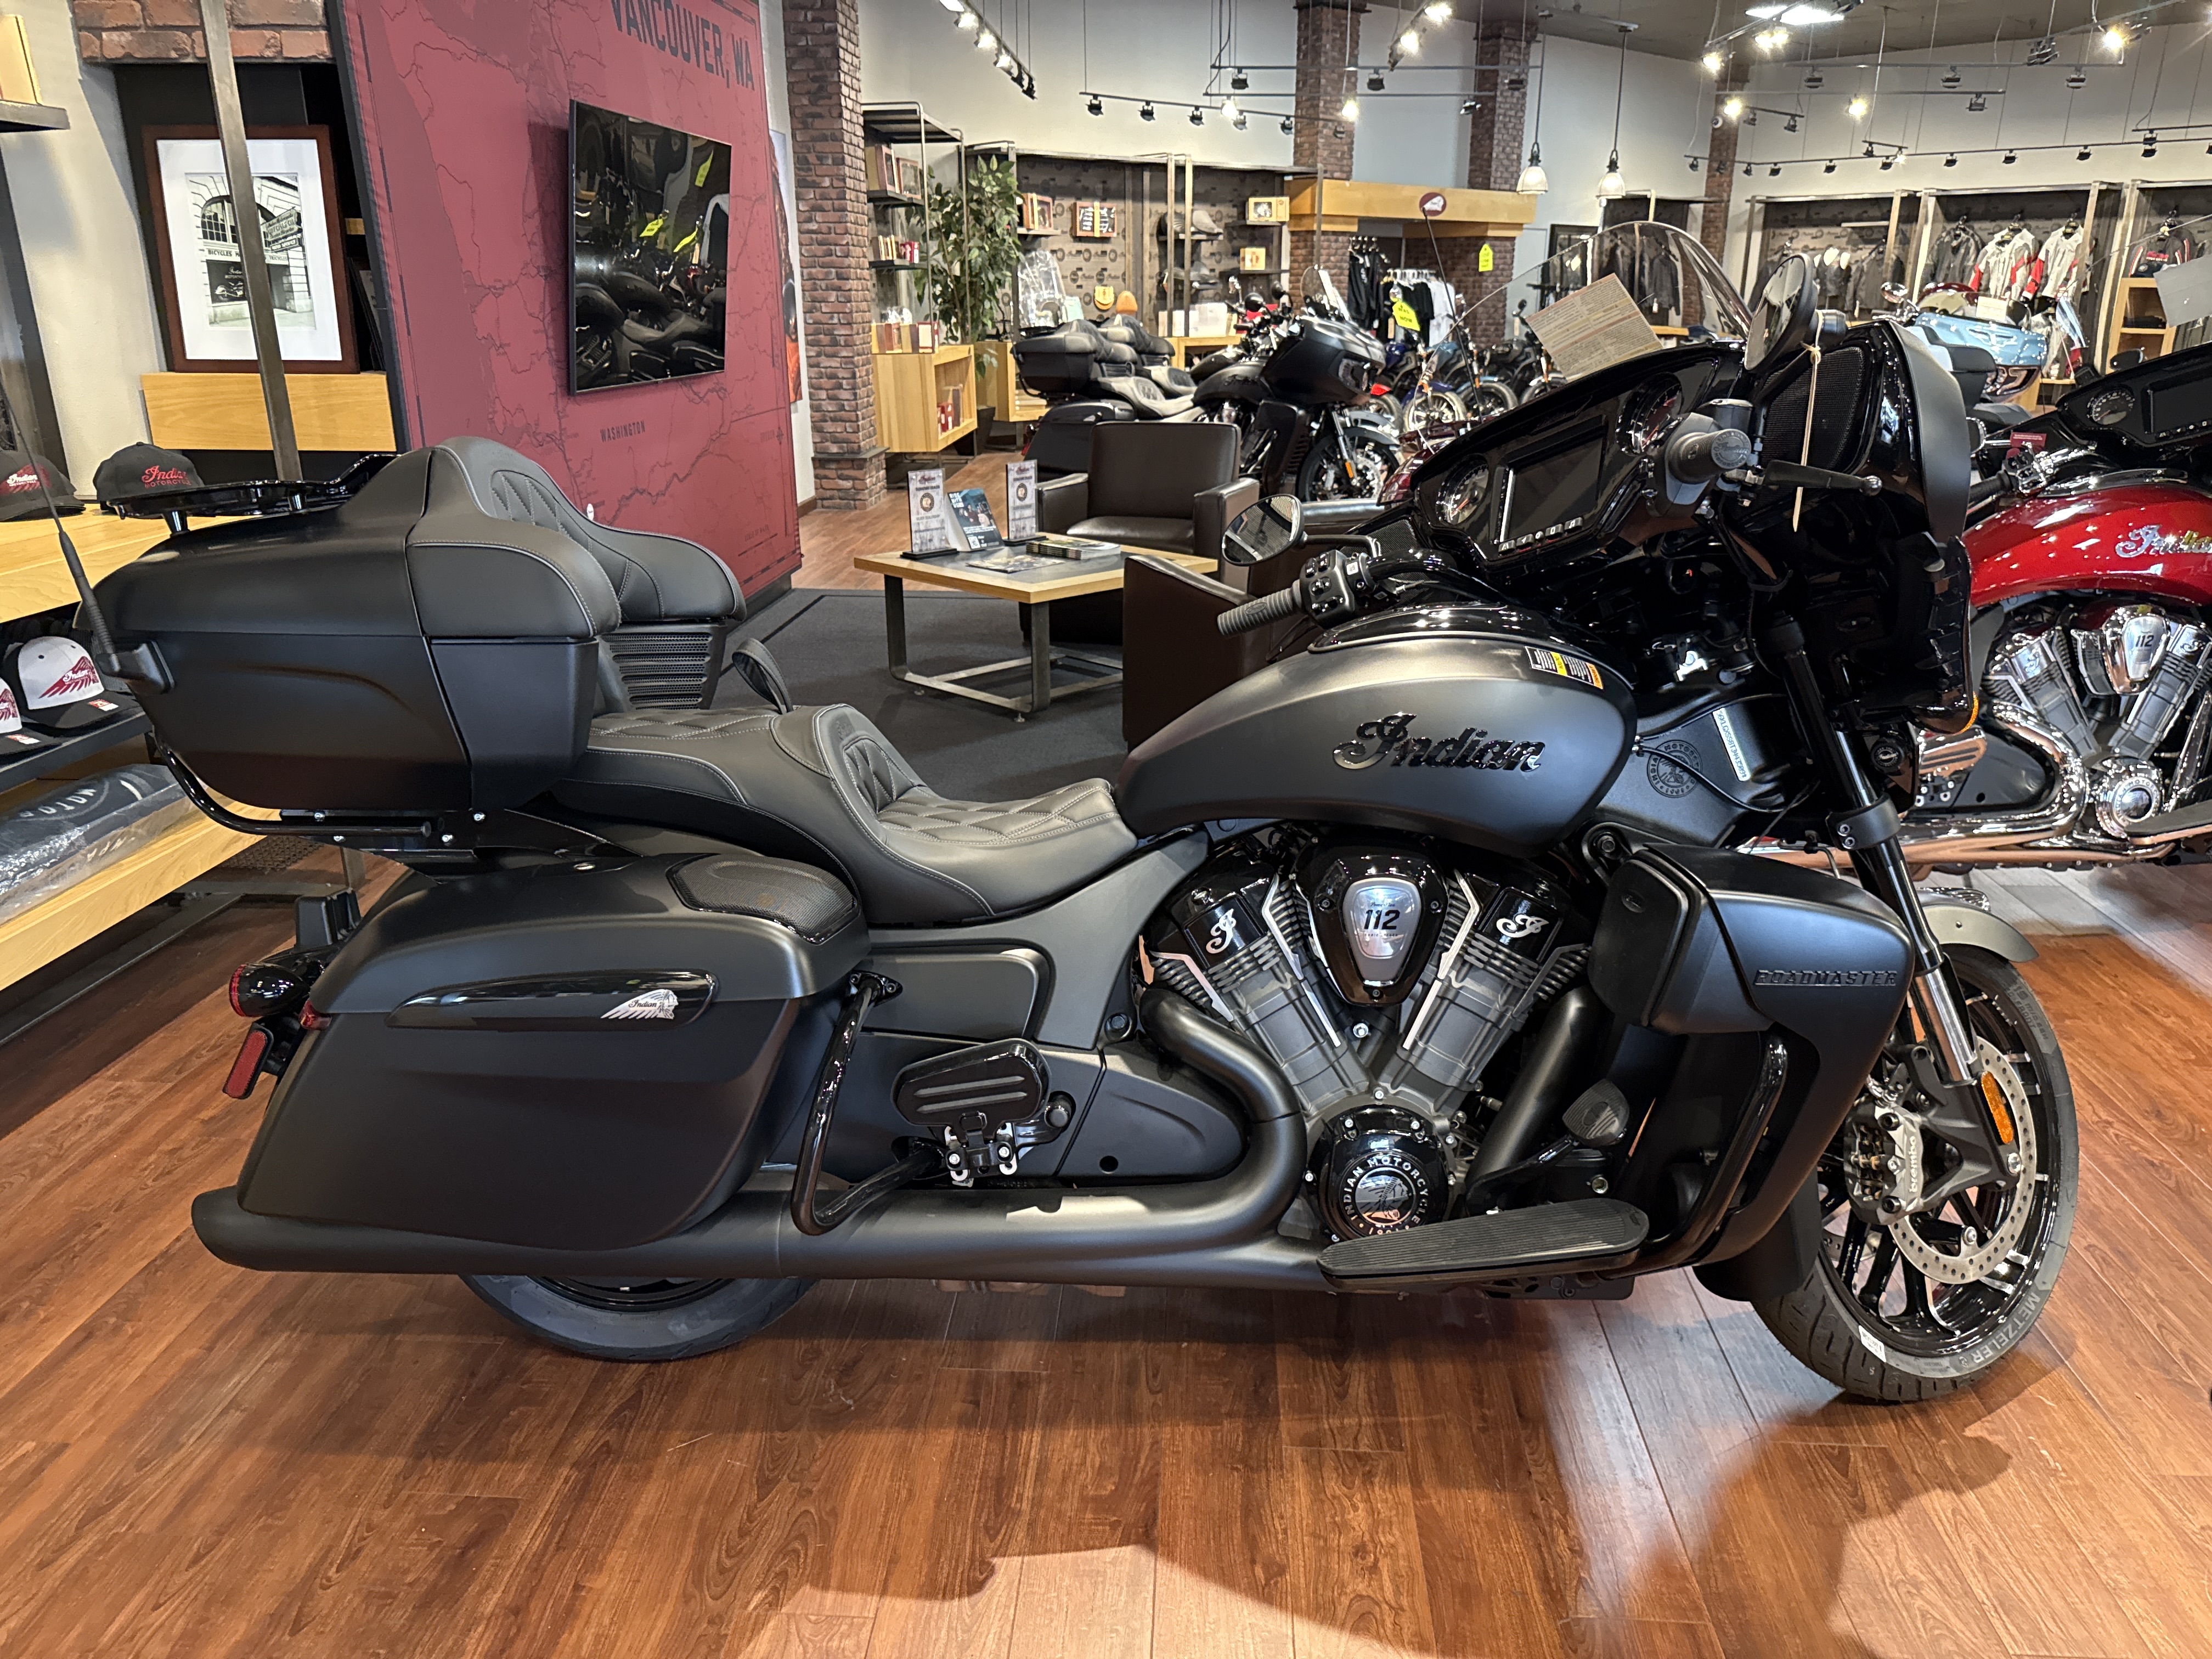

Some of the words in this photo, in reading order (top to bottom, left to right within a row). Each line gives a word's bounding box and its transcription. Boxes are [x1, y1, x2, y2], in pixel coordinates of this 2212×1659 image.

[611, 0, 730, 89] VANCOUVER,
[731, 33, 755, 92] WA
[600, 420, 646, 443] WASHINGTON
[7, 473, 38, 484] Indian
[2115, 523, 2212, 558] India
[2135, 634, 2155, 648] 112
[63, 669, 89, 682] Indian
[1332, 711, 1546, 772] Indian
[1364, 909, 1401, 930] 112
[1754, 969, 1898, 986] ROADMASTER
[628, 999, 658, 1008] Indian
[2014, 1000, 2036, 1029] FRONT
[1908, 1136, 1918, 1193] brembo
[1343, 1166, 1364, 1221] INDIAN
[1367, 1155, 1429, 1224] MOTORCYCLE
[1973, 1291, 2041, 1364] METZELER
